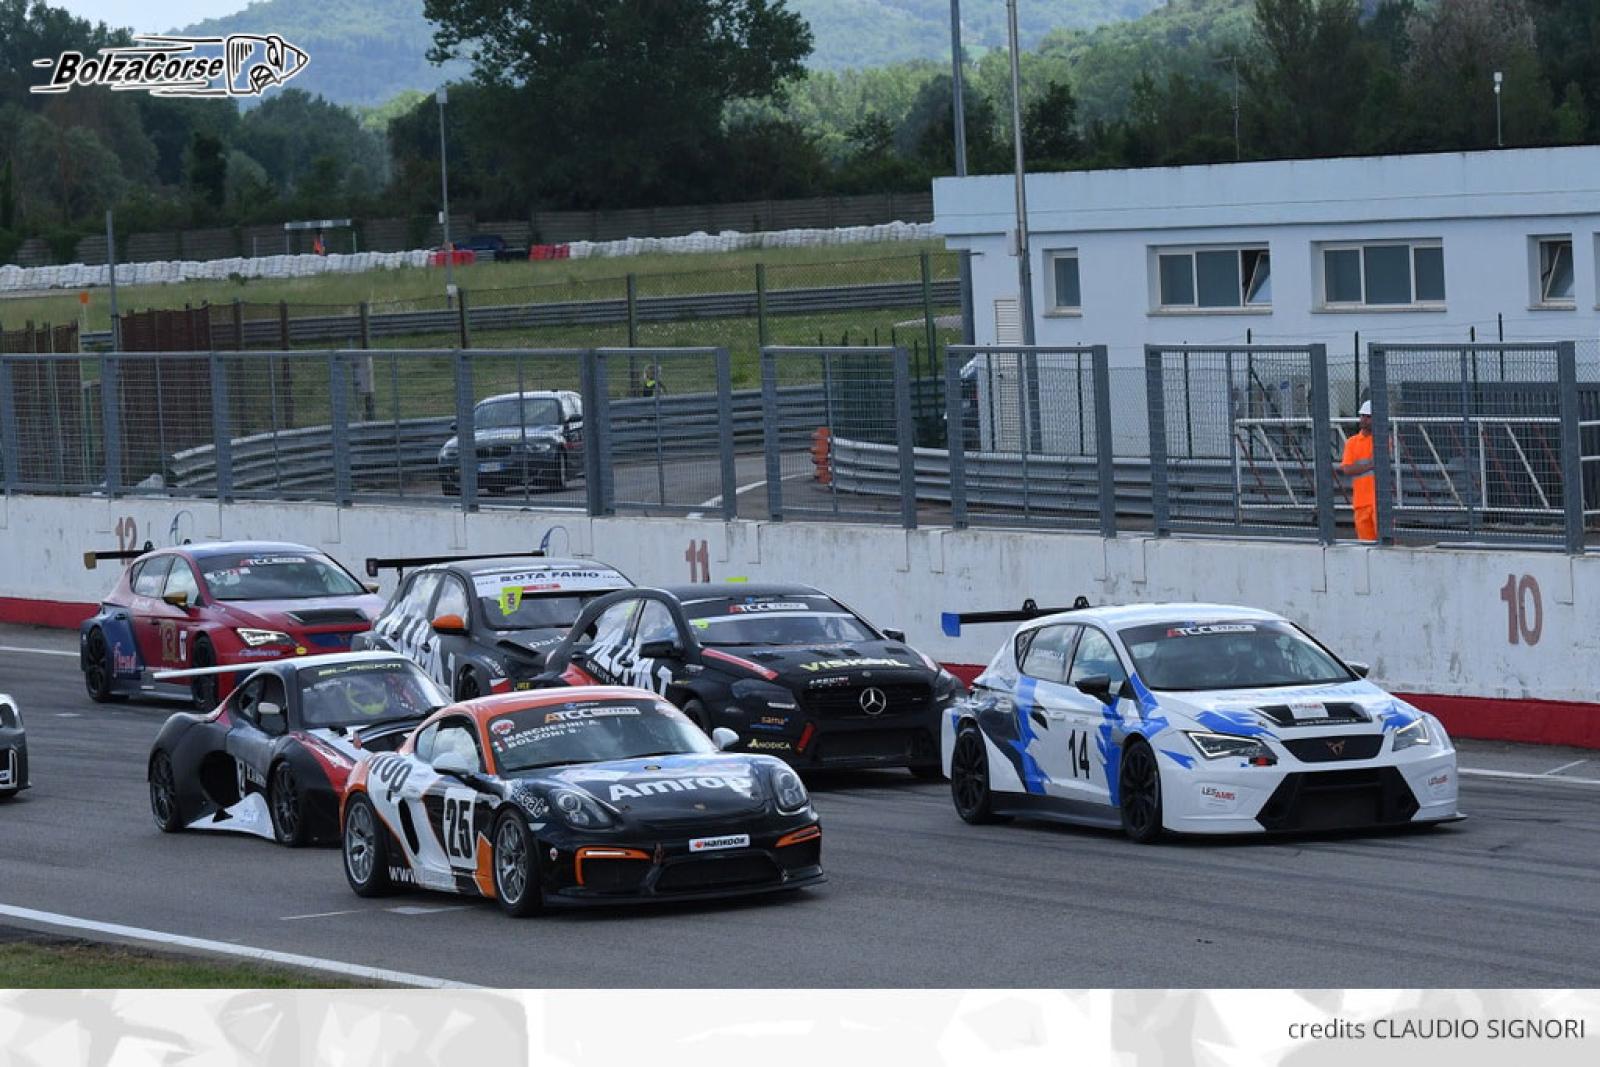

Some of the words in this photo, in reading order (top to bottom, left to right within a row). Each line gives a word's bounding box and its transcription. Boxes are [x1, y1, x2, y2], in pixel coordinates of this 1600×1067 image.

[501, 572, 546, 582] ROTA
[686, 539, 710, 583] 11
[1501, 574, 1542, 646] 10
[545, 709, 593, 724] ATCC
[1069, 729, 1090, 779] 14
[609, 776, 753, 801] Amrop
[446, 797, 472, 859] 25
